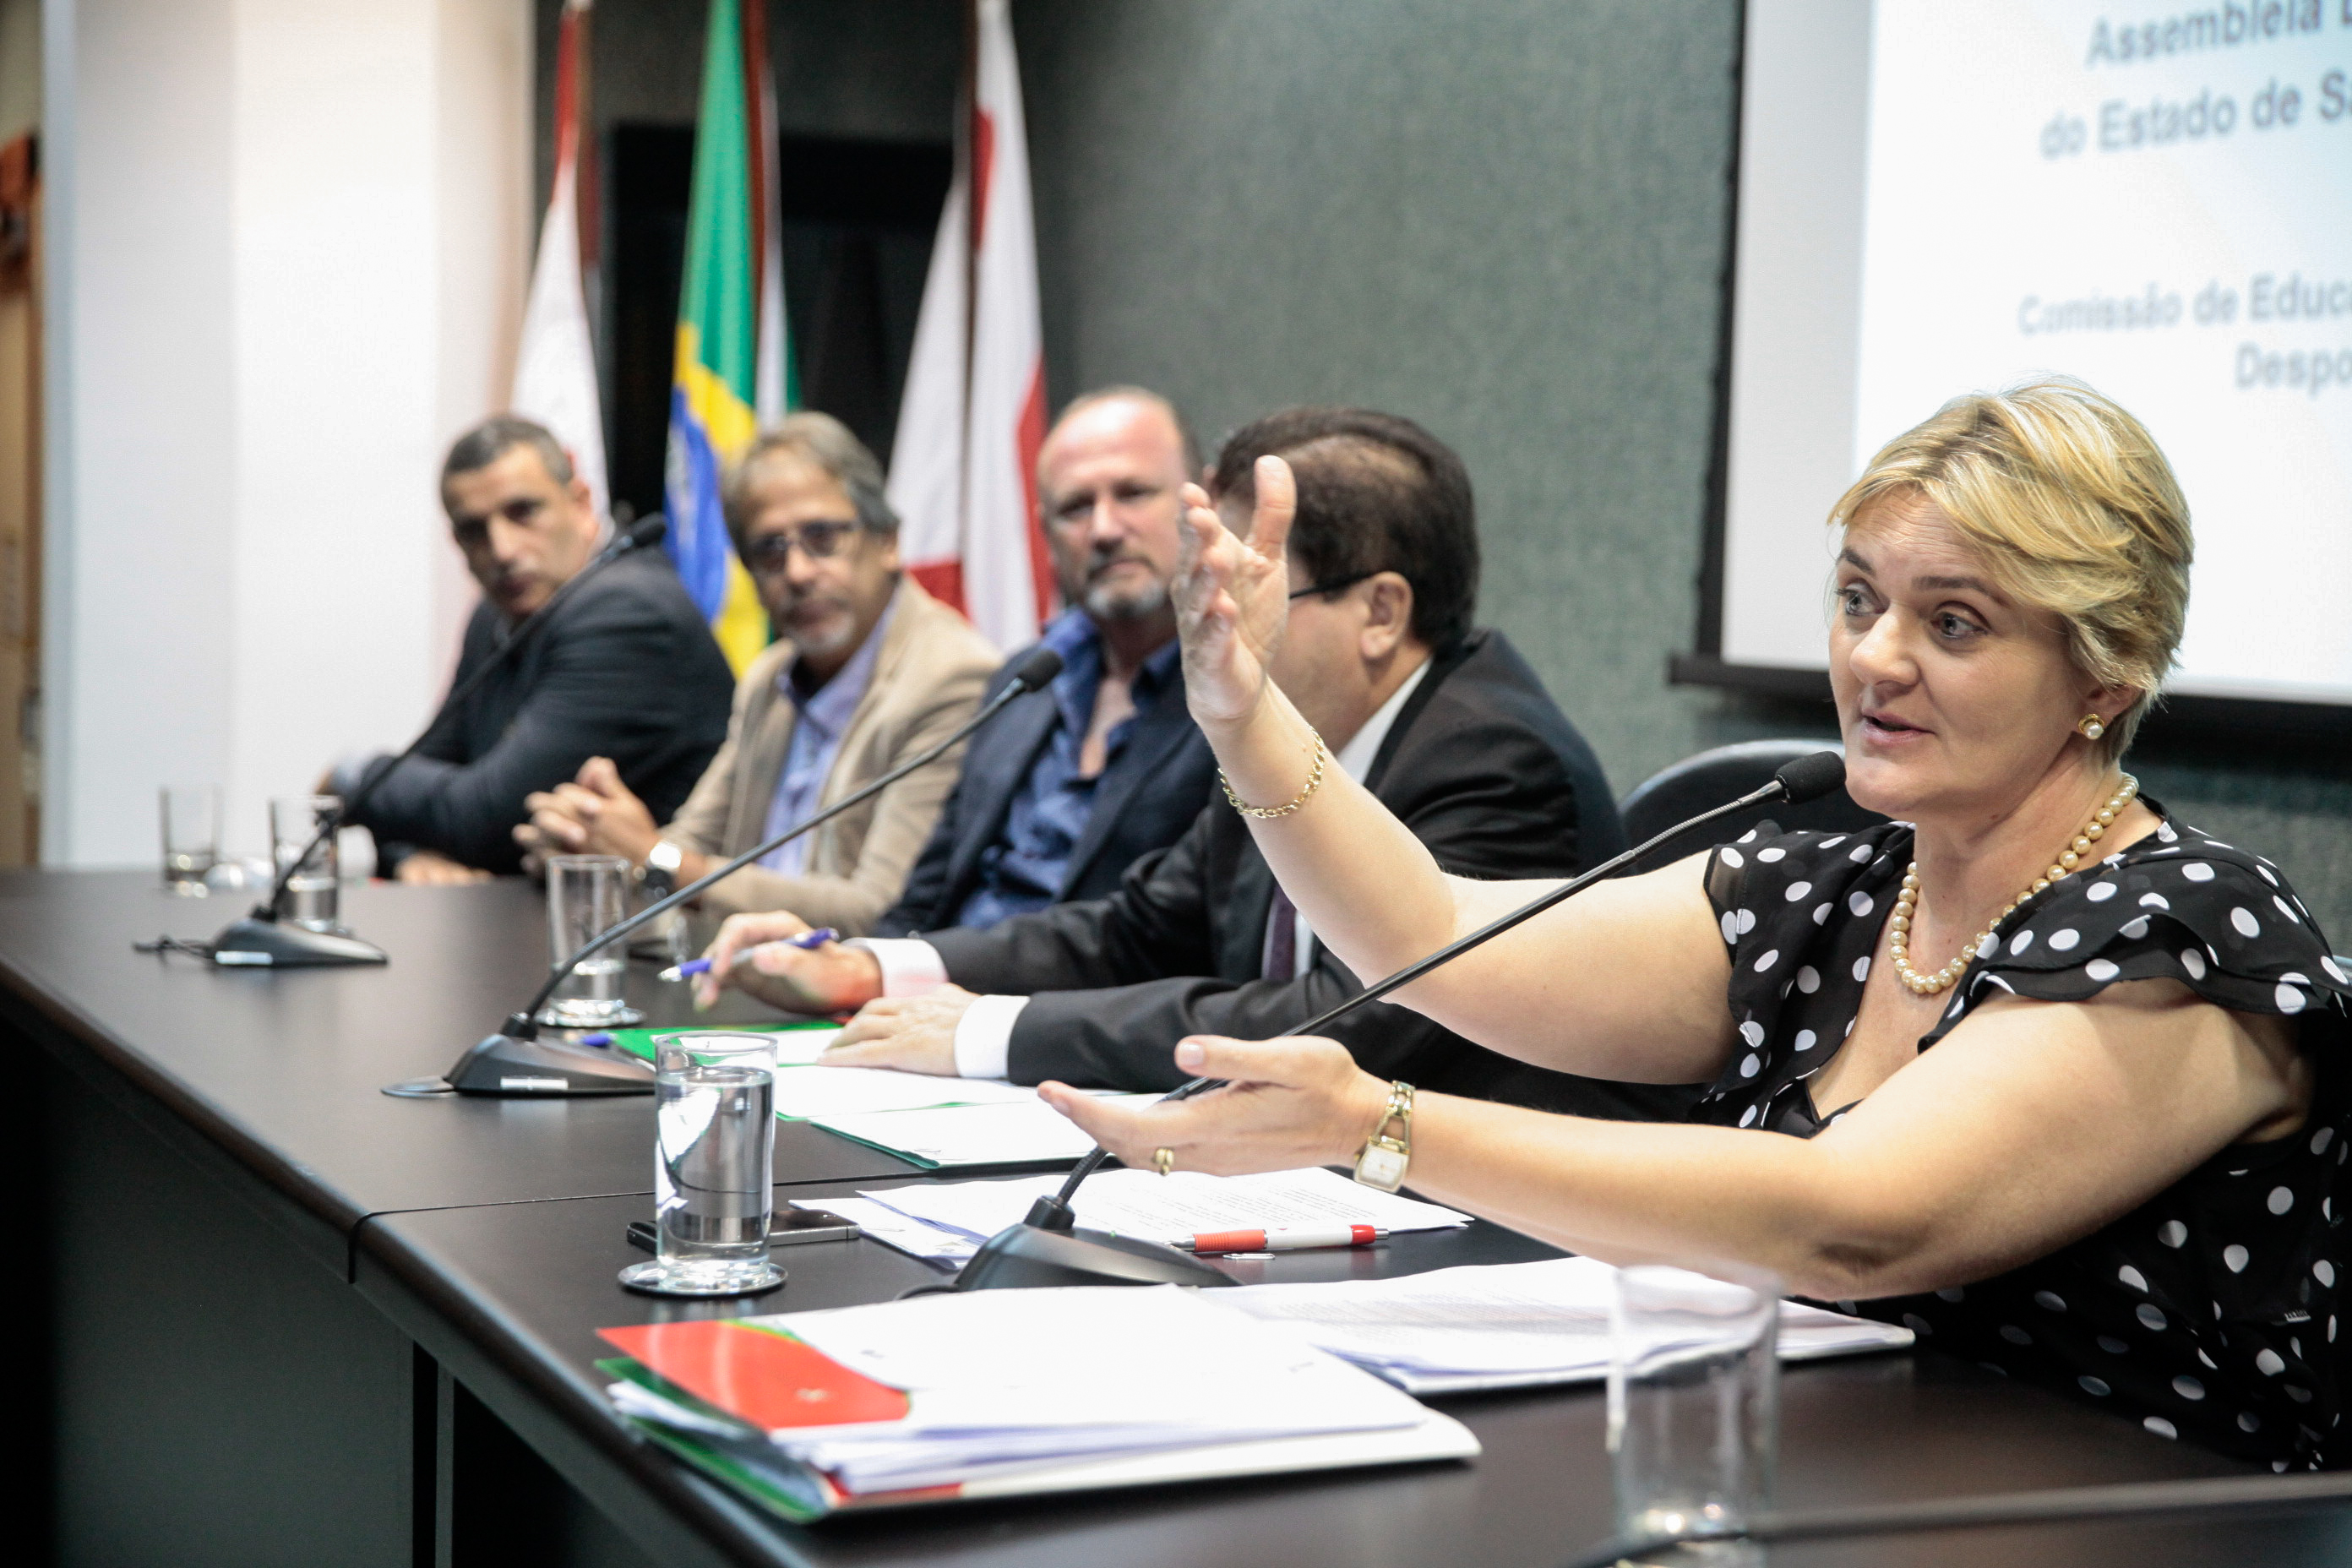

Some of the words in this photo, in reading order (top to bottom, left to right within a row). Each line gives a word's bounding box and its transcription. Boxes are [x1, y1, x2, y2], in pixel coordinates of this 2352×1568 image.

[2041, 112, 2086, 160] do
[2098, 87, 2235, 152] Estado
[2252, 78, 2300, 129] de
[2321, 68, 2352, 121] S
[2195, 280, 2239, 325] de
[2250, 271, 2352, 321] Educ
